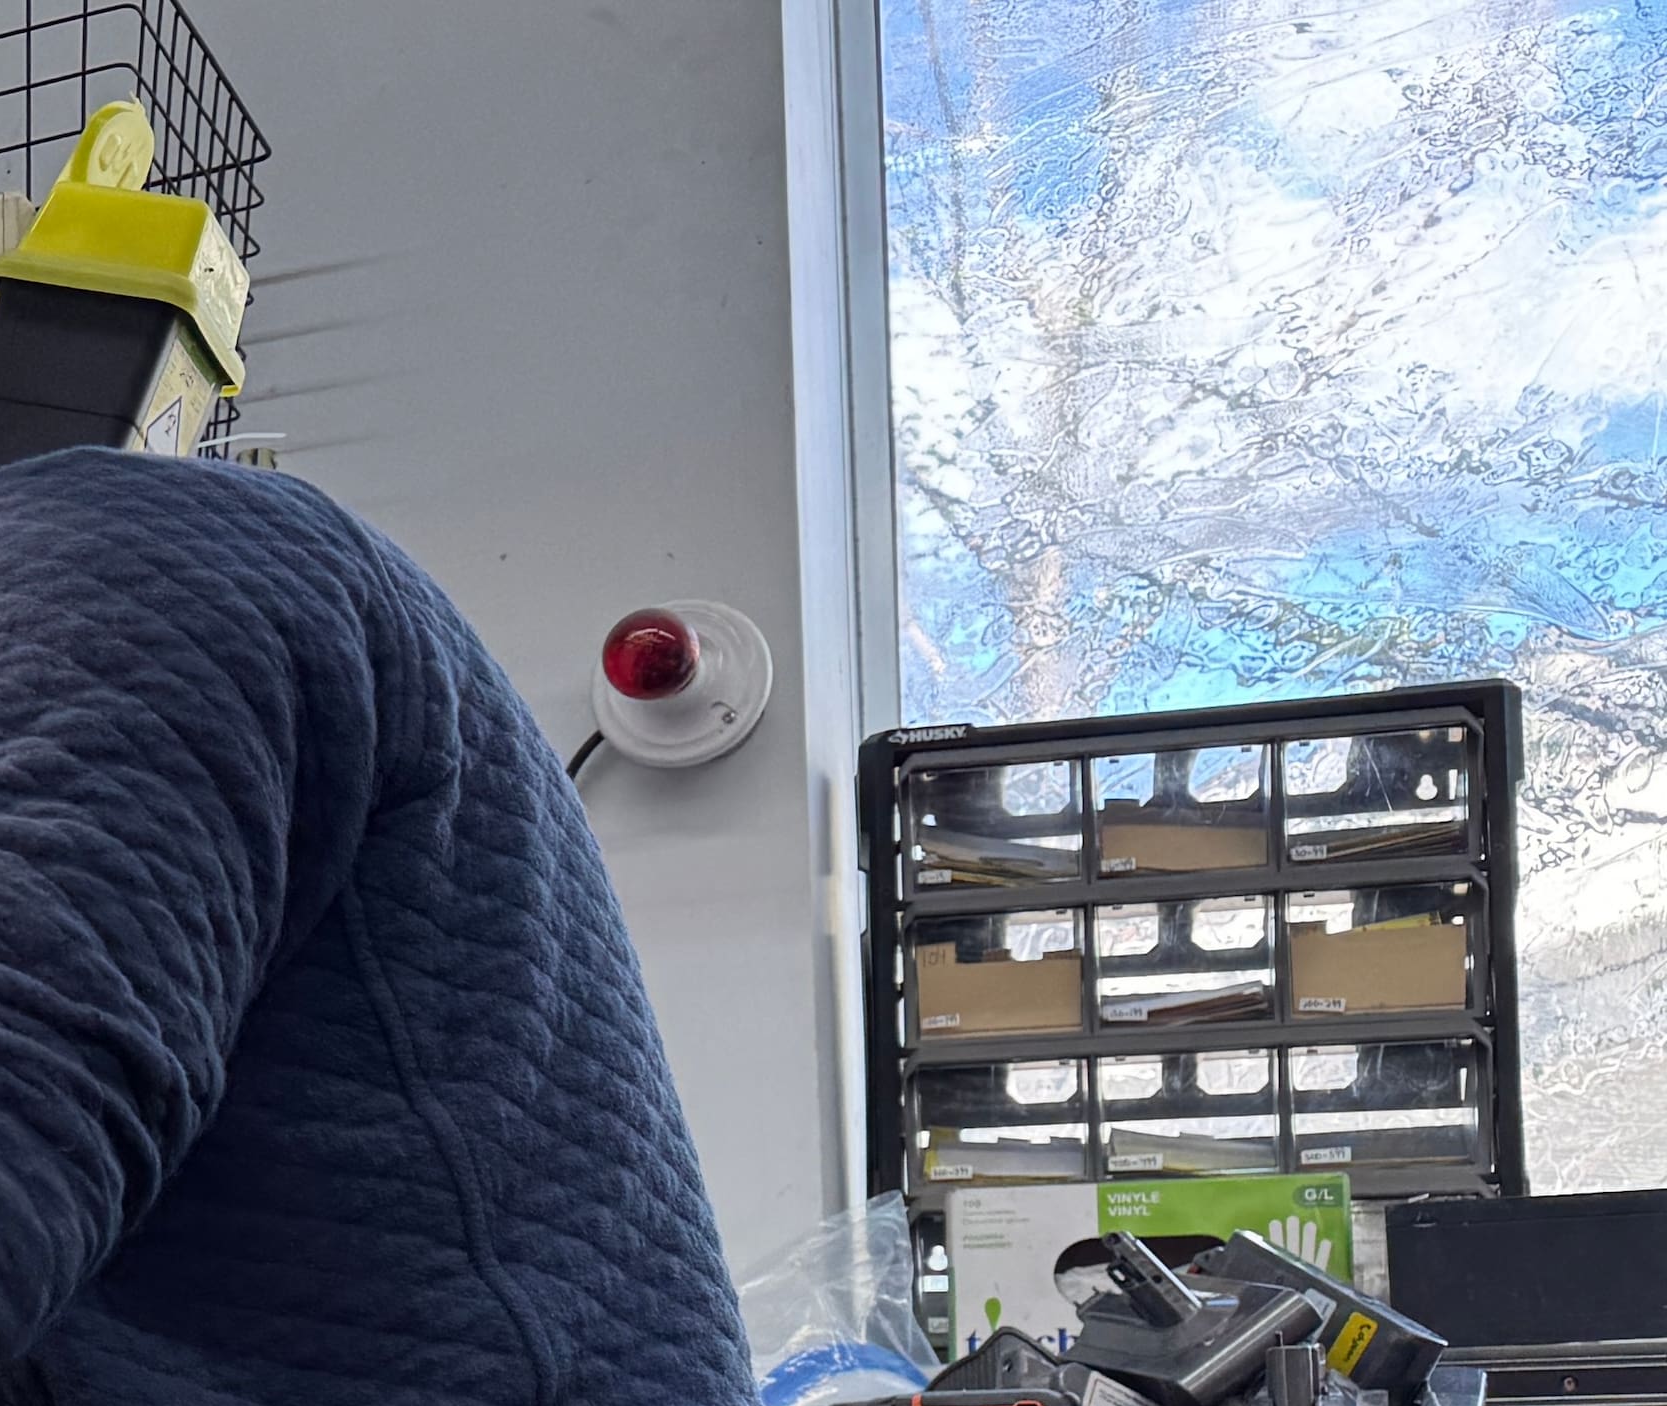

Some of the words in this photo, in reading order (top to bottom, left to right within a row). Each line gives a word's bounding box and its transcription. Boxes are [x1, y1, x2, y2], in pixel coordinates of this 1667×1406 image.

[909, 725, 967, 743] HUSKY
[1107, 1191, 1160, 1205] VINYLE
[1304, 1187, 1335, 1201] G/L
[1108, 1204, 1151, 1217] VINYL
